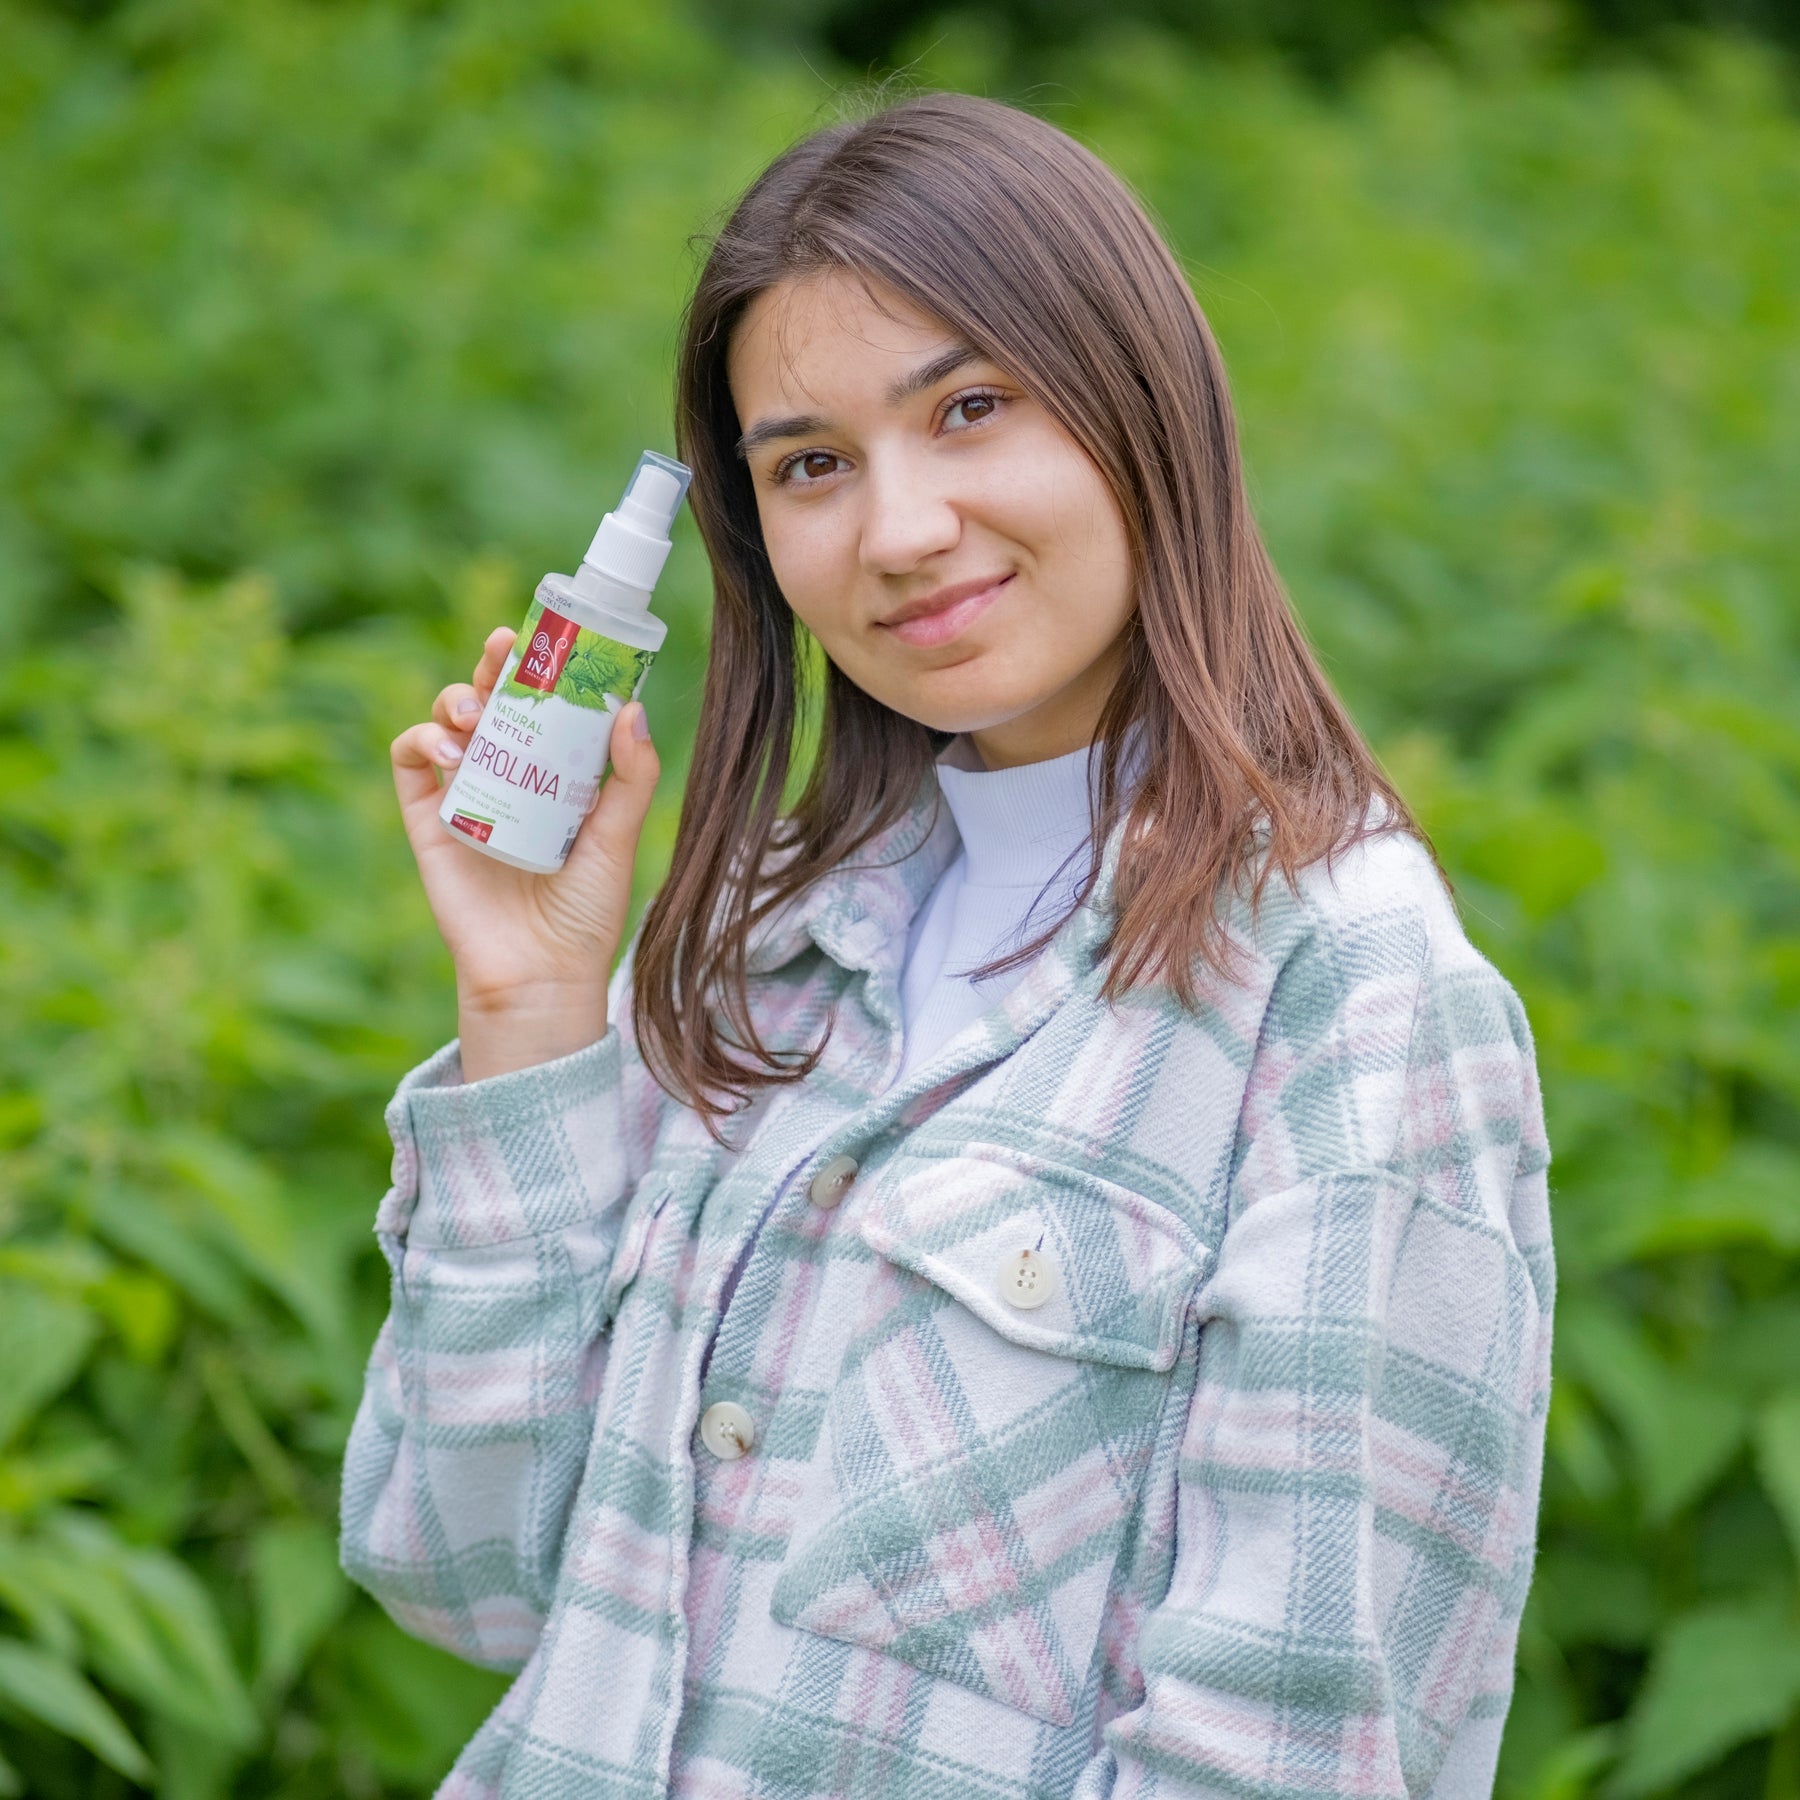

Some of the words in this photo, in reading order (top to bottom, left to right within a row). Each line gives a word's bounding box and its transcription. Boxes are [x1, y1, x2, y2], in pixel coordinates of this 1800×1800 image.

[527, 657, 550, 680] INA
[491, 716, 534, 747] NETTLE
[495, 701, 543, 735] NATURAL
[491, 806, 520, 824] GROWTH
